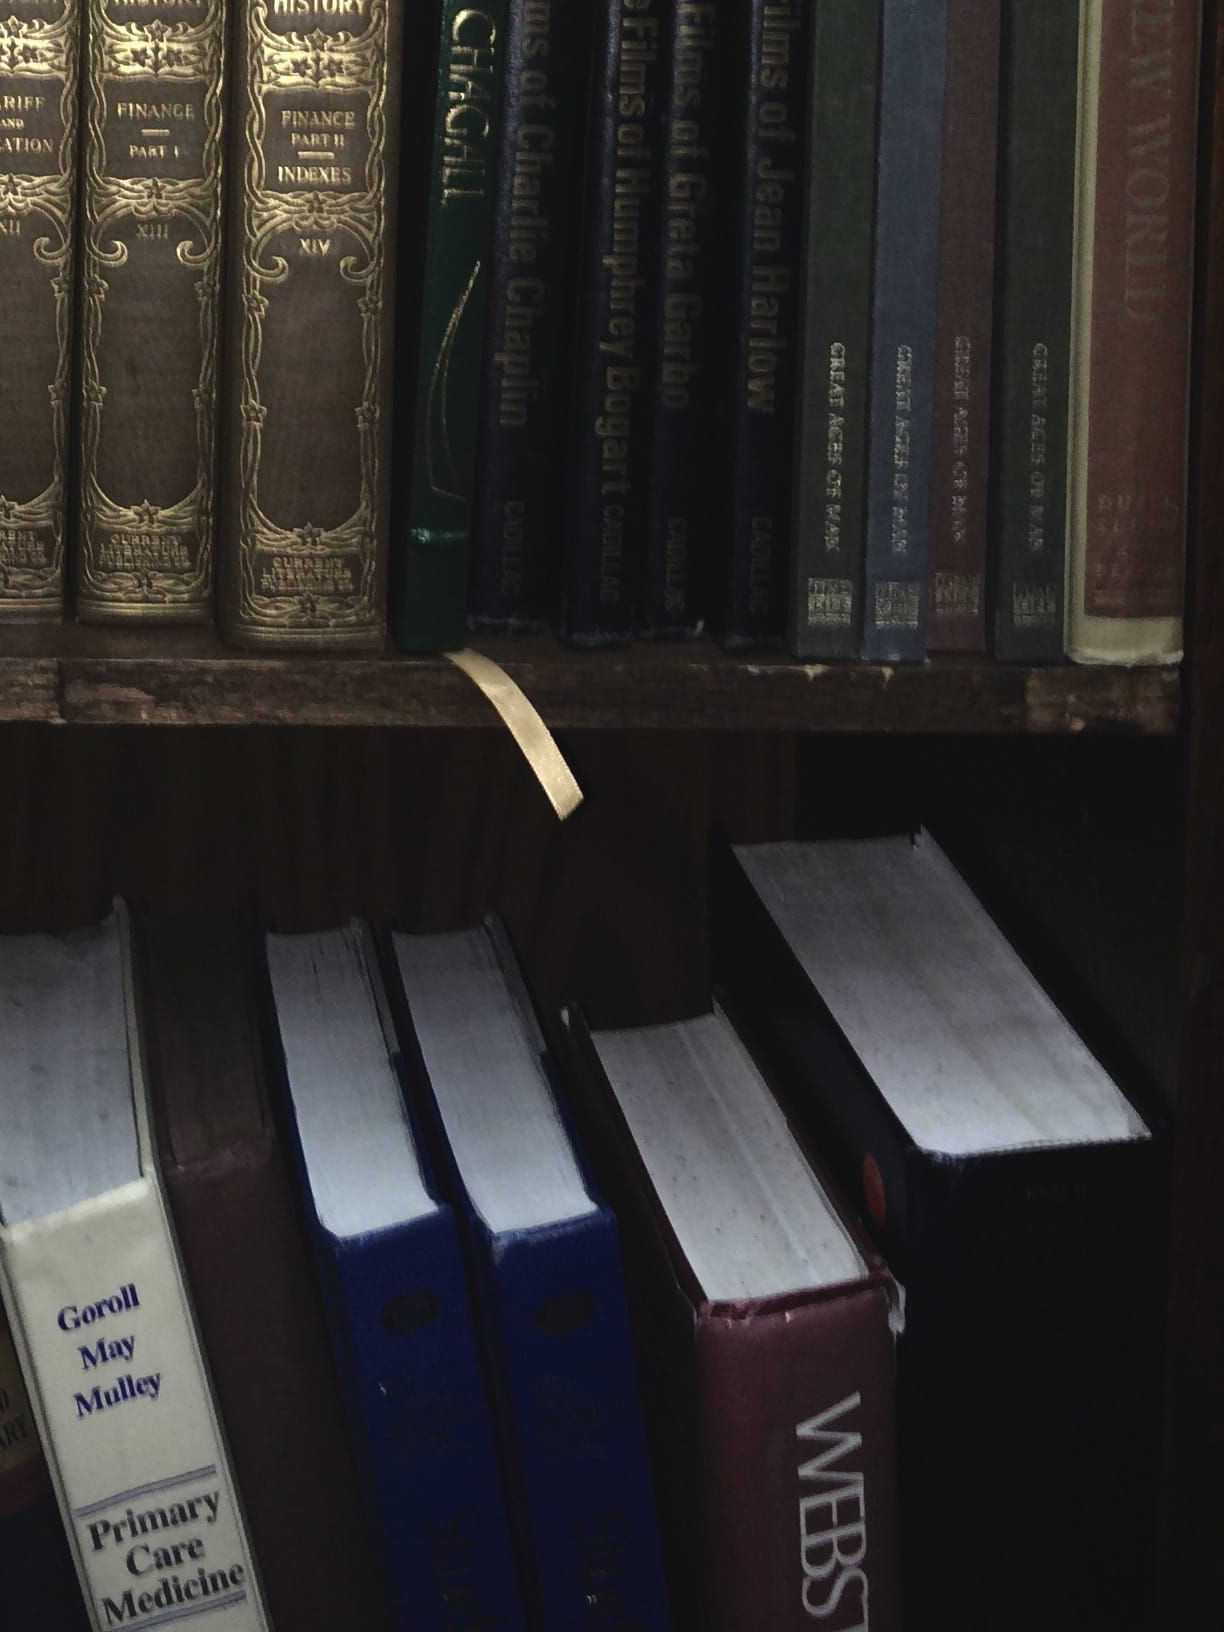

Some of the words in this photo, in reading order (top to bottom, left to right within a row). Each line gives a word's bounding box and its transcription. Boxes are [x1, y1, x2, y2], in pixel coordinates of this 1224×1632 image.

[618, 17, 658, 118] Films
[674, 2, 717, 109] Films
[281, 111, 356, 127] FINANCE
[440, 8, 497, 204] CHAGALL
[520, 69, 556, 110] of
[291, 132, 328, 147] PART
[332, 133, 345, 146] II
[615, 123, 652, 159] of
[671, 119, 709, 160] of
[757, 100, 796, 143] of
[277, 166, 352, 183] INDEXES
[508, 122, 554, 264] Charlie
[753, 155, 795, 251] Jean
[298, 238, 330, 255] XIV
[666, 170, 709, 282] Greta
[1124, 109, 1175, 322] WORLD
[599, 167, 650, 357] Humphrey
[489, 276, 545, 428] Chaplin
[661, 292, 703, 411] Garbo
[745, 264, 792, 416] Harlow
[829, 341, 846, 410] GREAT
[594, 364, 642, 496] Bogart
[57, 1283, 140, 1332] Goroll
[78, 1336, 135, 1369] May
[74, 1372, 161, 1417] Mulley
[87, 1491, 220, 1552] Primary
[126, 1537, 205, 1576] Care
[101, 1563, 245, 1625] Medicine
